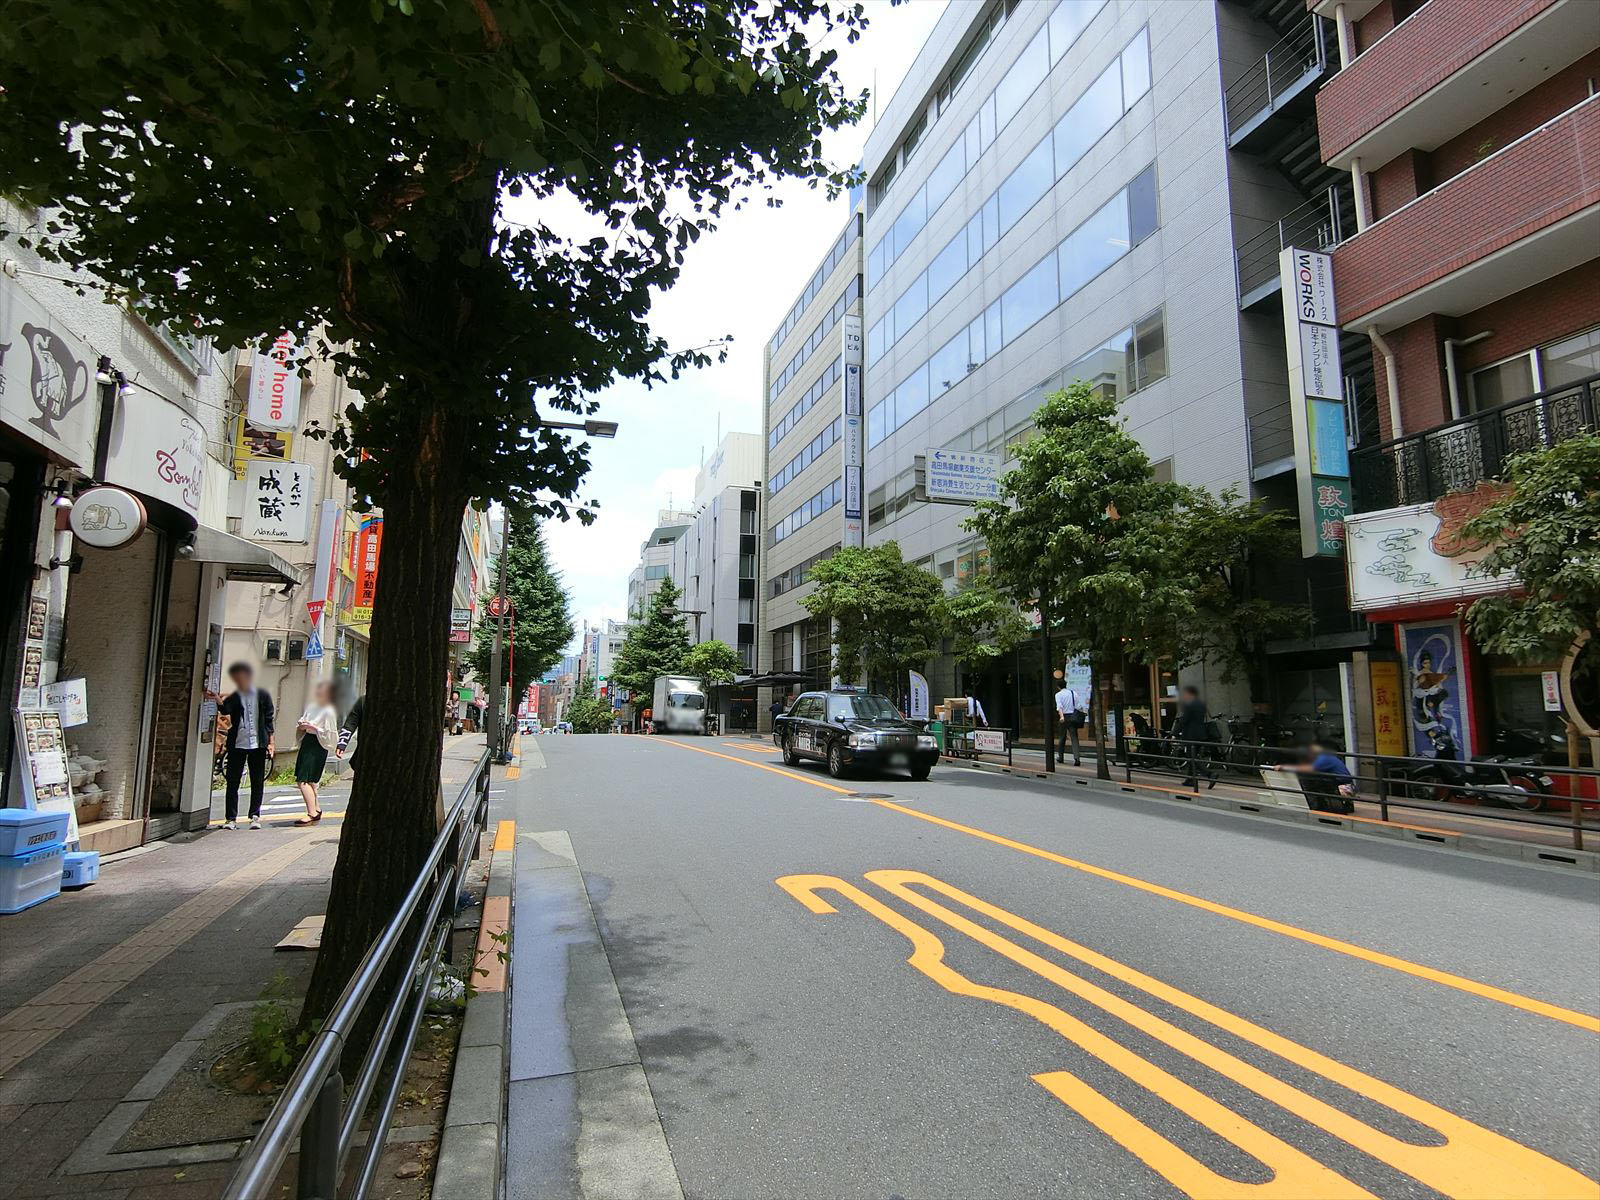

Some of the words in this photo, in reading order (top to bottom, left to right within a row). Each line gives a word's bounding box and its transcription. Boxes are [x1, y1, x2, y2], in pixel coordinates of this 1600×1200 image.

[1298, 254, 1315, 318] WORKS
[847, 343, 859, 352] ビル
[270, 372, 288, 420] home
[258, 469, 285, 522] 成蔵
[290, 471, 302, 508] とんかつ
[1321, 507, 1345, 519] TON
